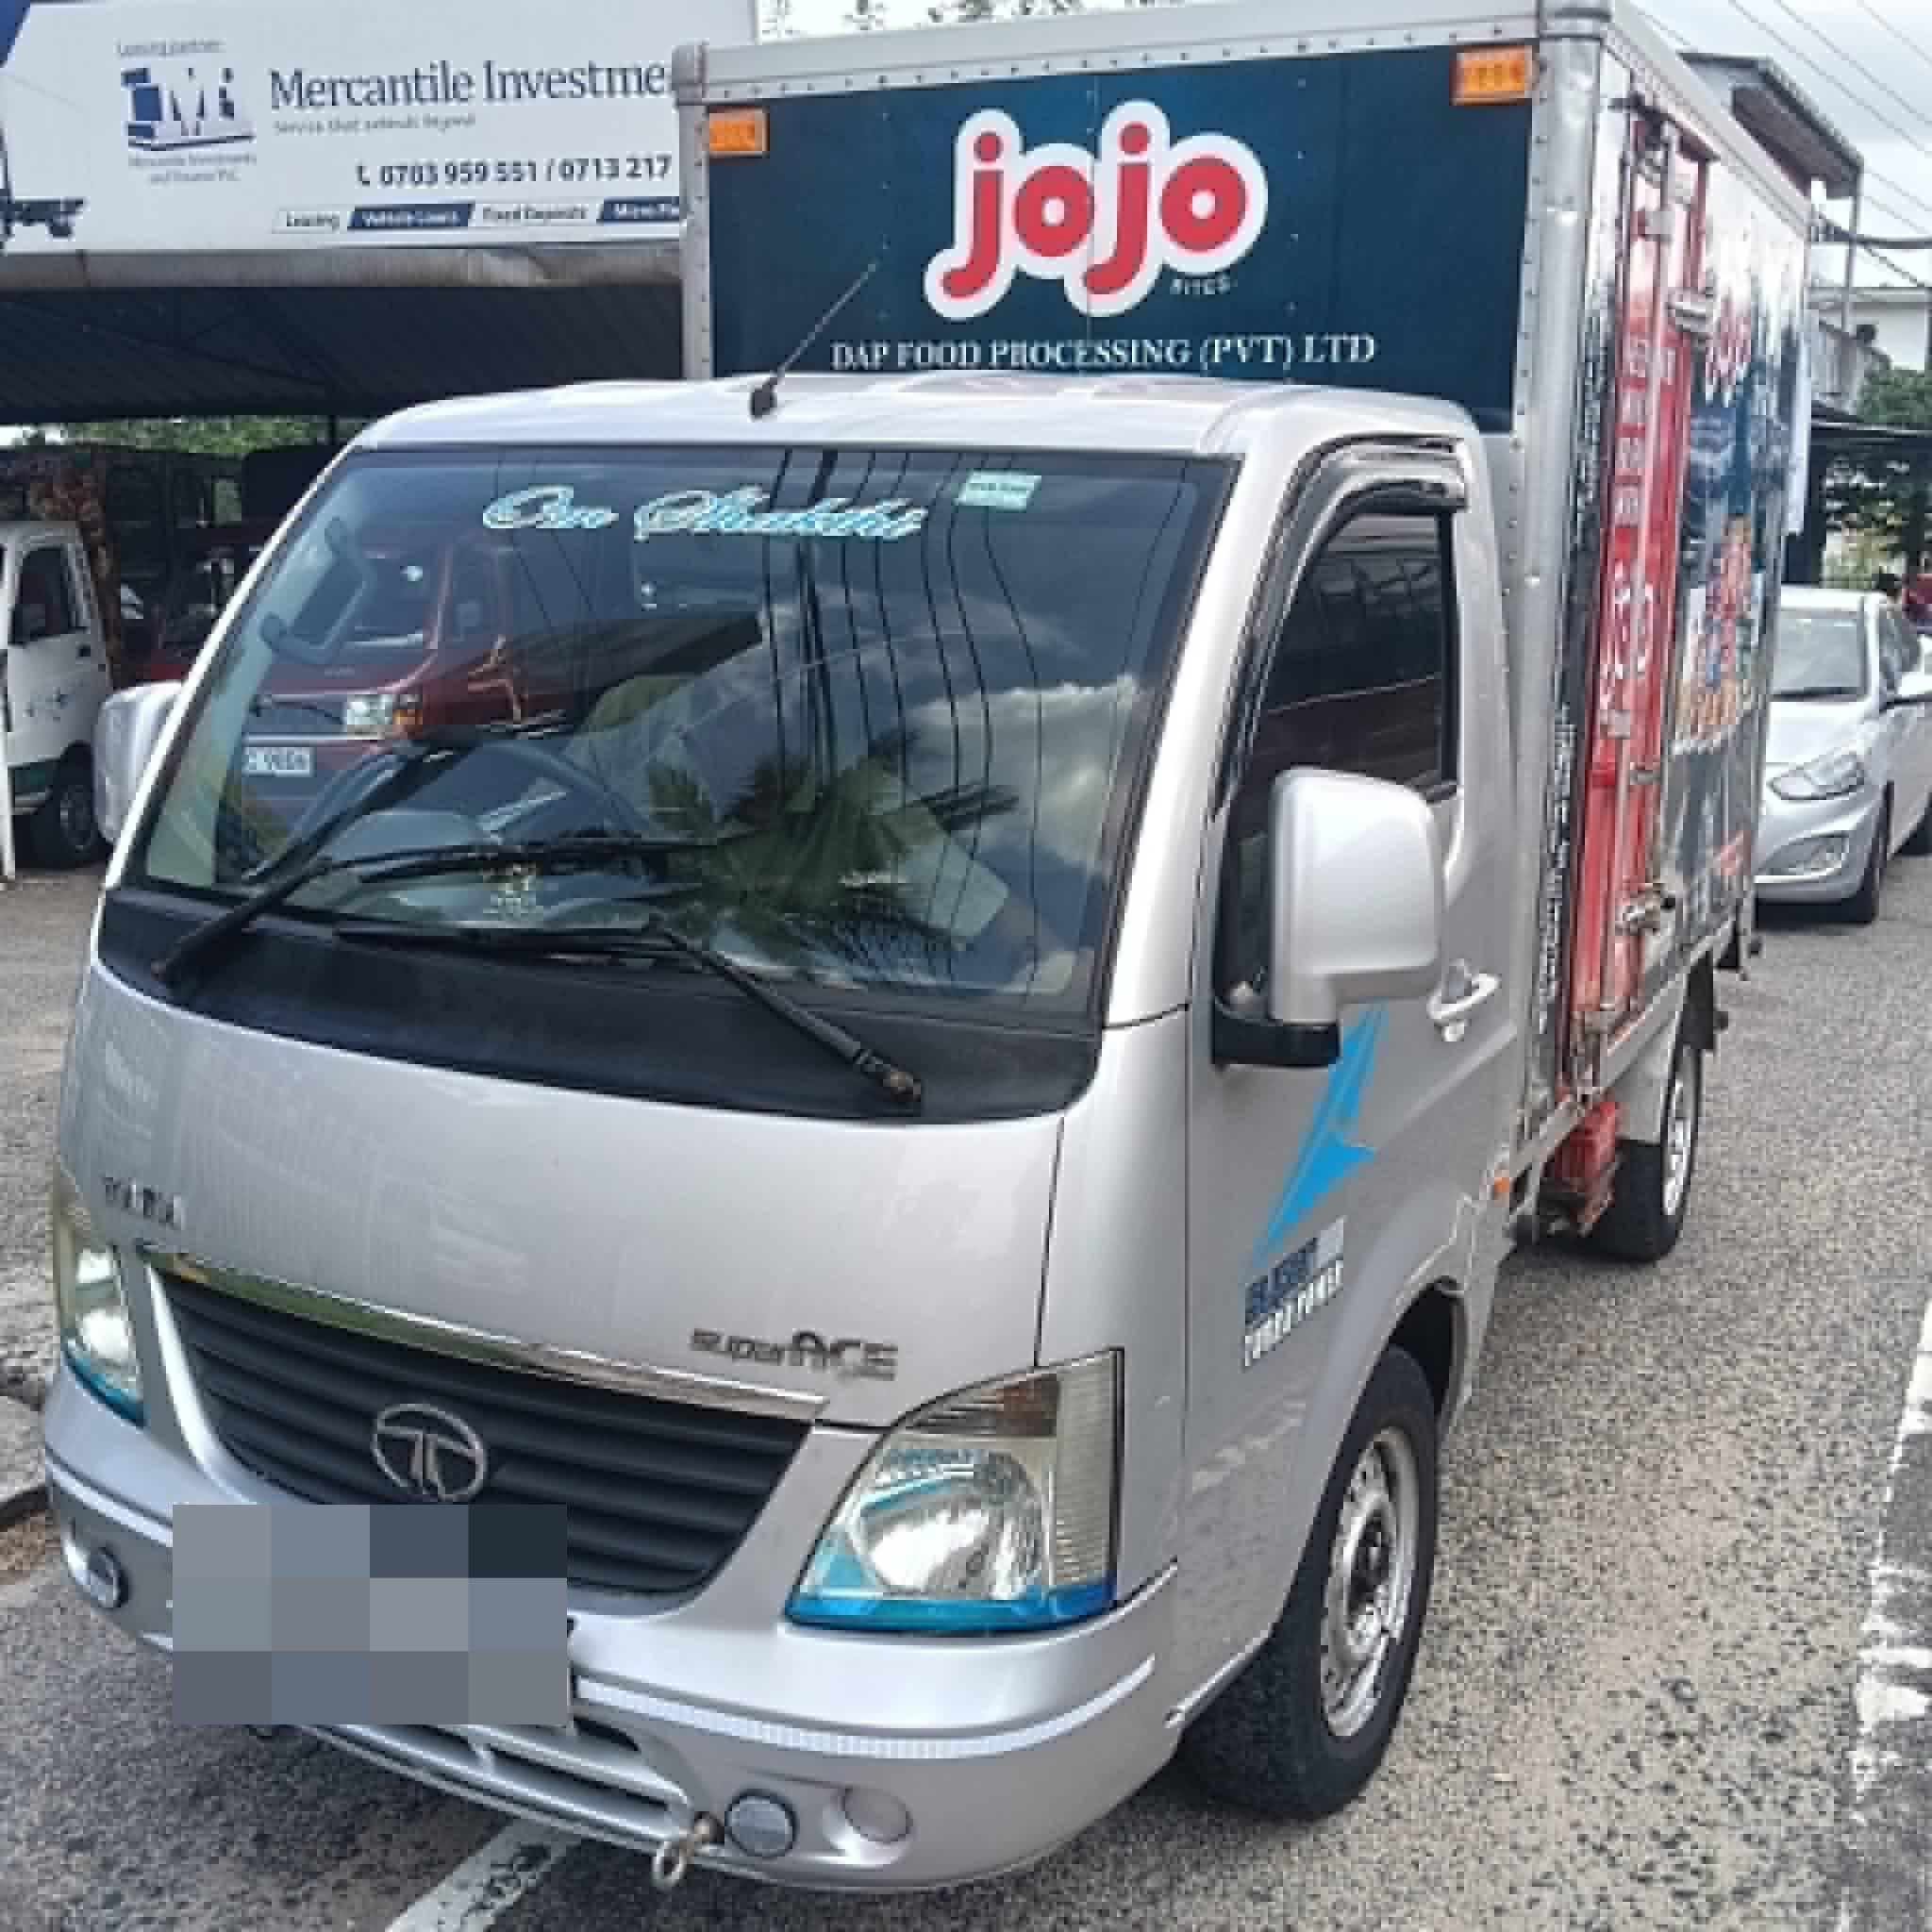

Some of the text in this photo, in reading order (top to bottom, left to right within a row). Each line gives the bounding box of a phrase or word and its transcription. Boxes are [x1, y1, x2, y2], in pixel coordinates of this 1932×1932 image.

[271, 58, 668, 111] Mercantile Investme
[443, 158, 488, 186] 959
[558, 157, 619, 182] 0713
[626, 154, 672, 180] 217
[934, 111, 1258, 309] jojo
[830, 331, 1376, 373] DAP FOOD PROCESSING (PVT) LTD
